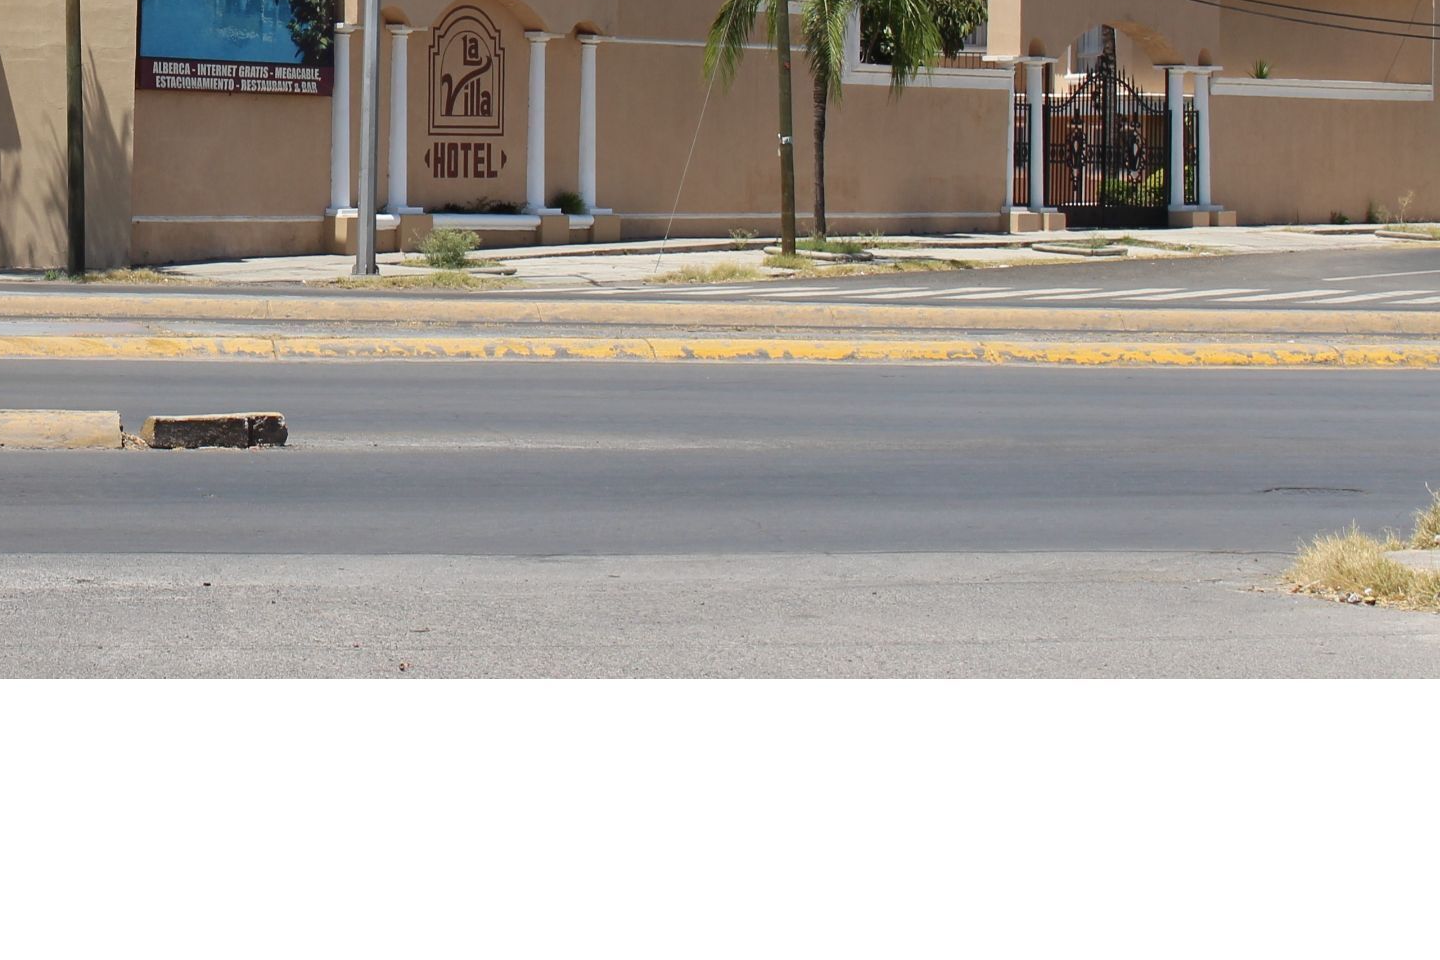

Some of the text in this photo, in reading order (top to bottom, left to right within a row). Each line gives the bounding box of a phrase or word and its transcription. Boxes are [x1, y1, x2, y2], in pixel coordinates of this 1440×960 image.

[462, 34, 483, 67] La
[152, 61, 191, 75] ALBERCA
[197, 63, 238, 78] INTERNET
[238, 65, 269, 79] GRATIS
[274, 66, 322, 82] MEGACABLE,
[155, 75, 235, 91] ESTACIONAMIENTO
[240, 79, 293, 93] RESTAURANT
[301, 81, 318, 94] BAR
[441, 56, 493, 117] Villa
[433, 142, 498, 179] HOTEL
